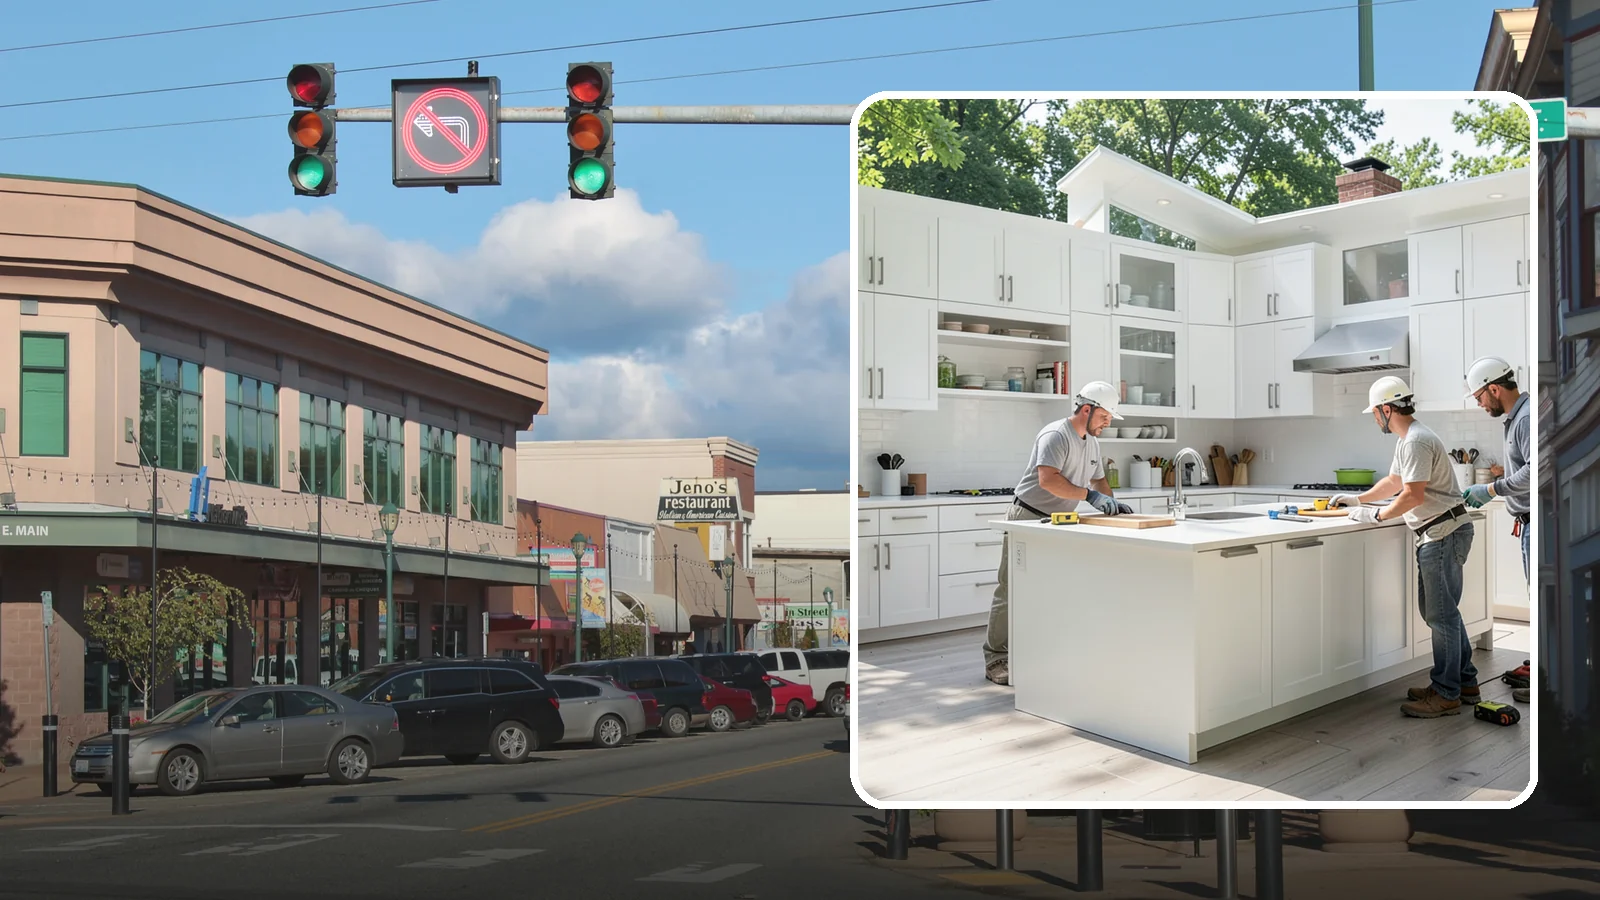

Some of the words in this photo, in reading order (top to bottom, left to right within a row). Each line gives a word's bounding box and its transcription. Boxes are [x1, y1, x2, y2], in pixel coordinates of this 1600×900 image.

[670, 480, 727, 494] Jeno's
[665, 496, 731, 509] restaurant
[659, 509, 681, 519] Italian
[686, 509, 714, 519] American
[715, 509, 737, 519] Cuisine
[2, 525, 13, 536] E.
[15, 525, 49, 536] MAIN
[797, 607, 828, 617] Street
[791, 619, 823, 627] lass
